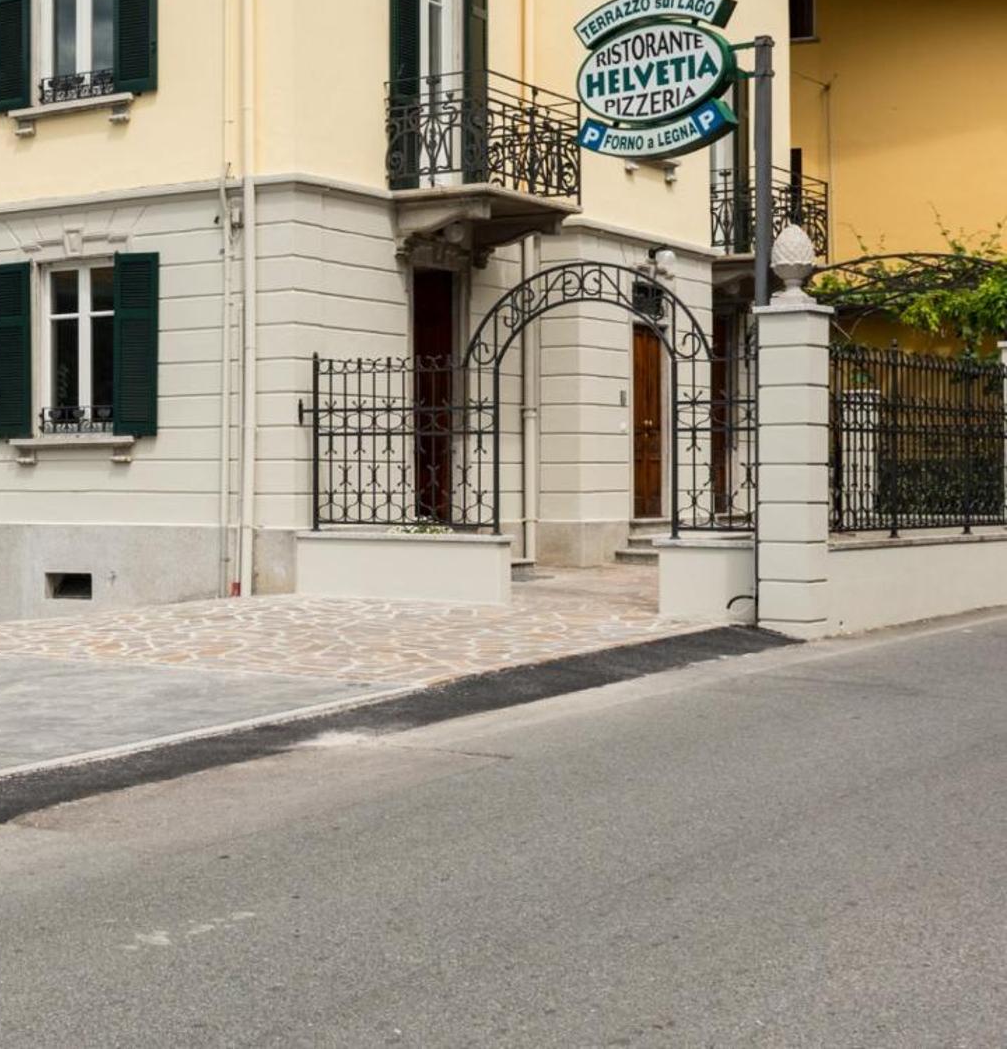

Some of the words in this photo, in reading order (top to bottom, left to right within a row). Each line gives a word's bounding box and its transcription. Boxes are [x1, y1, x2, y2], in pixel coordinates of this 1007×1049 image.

[595, 30, 704, 68] RISTORANTE
[586, 51, 719, 99] HELVETIA
[604, 86, 696, 118] PIZZERIA
[582, 126, 600, 144] P
[603, 133, 644, 150] FORNO
[647, 138, 654, 149] a
[657, 122, 698, 147] LEGNA
[698, 109, 716, 131] P
